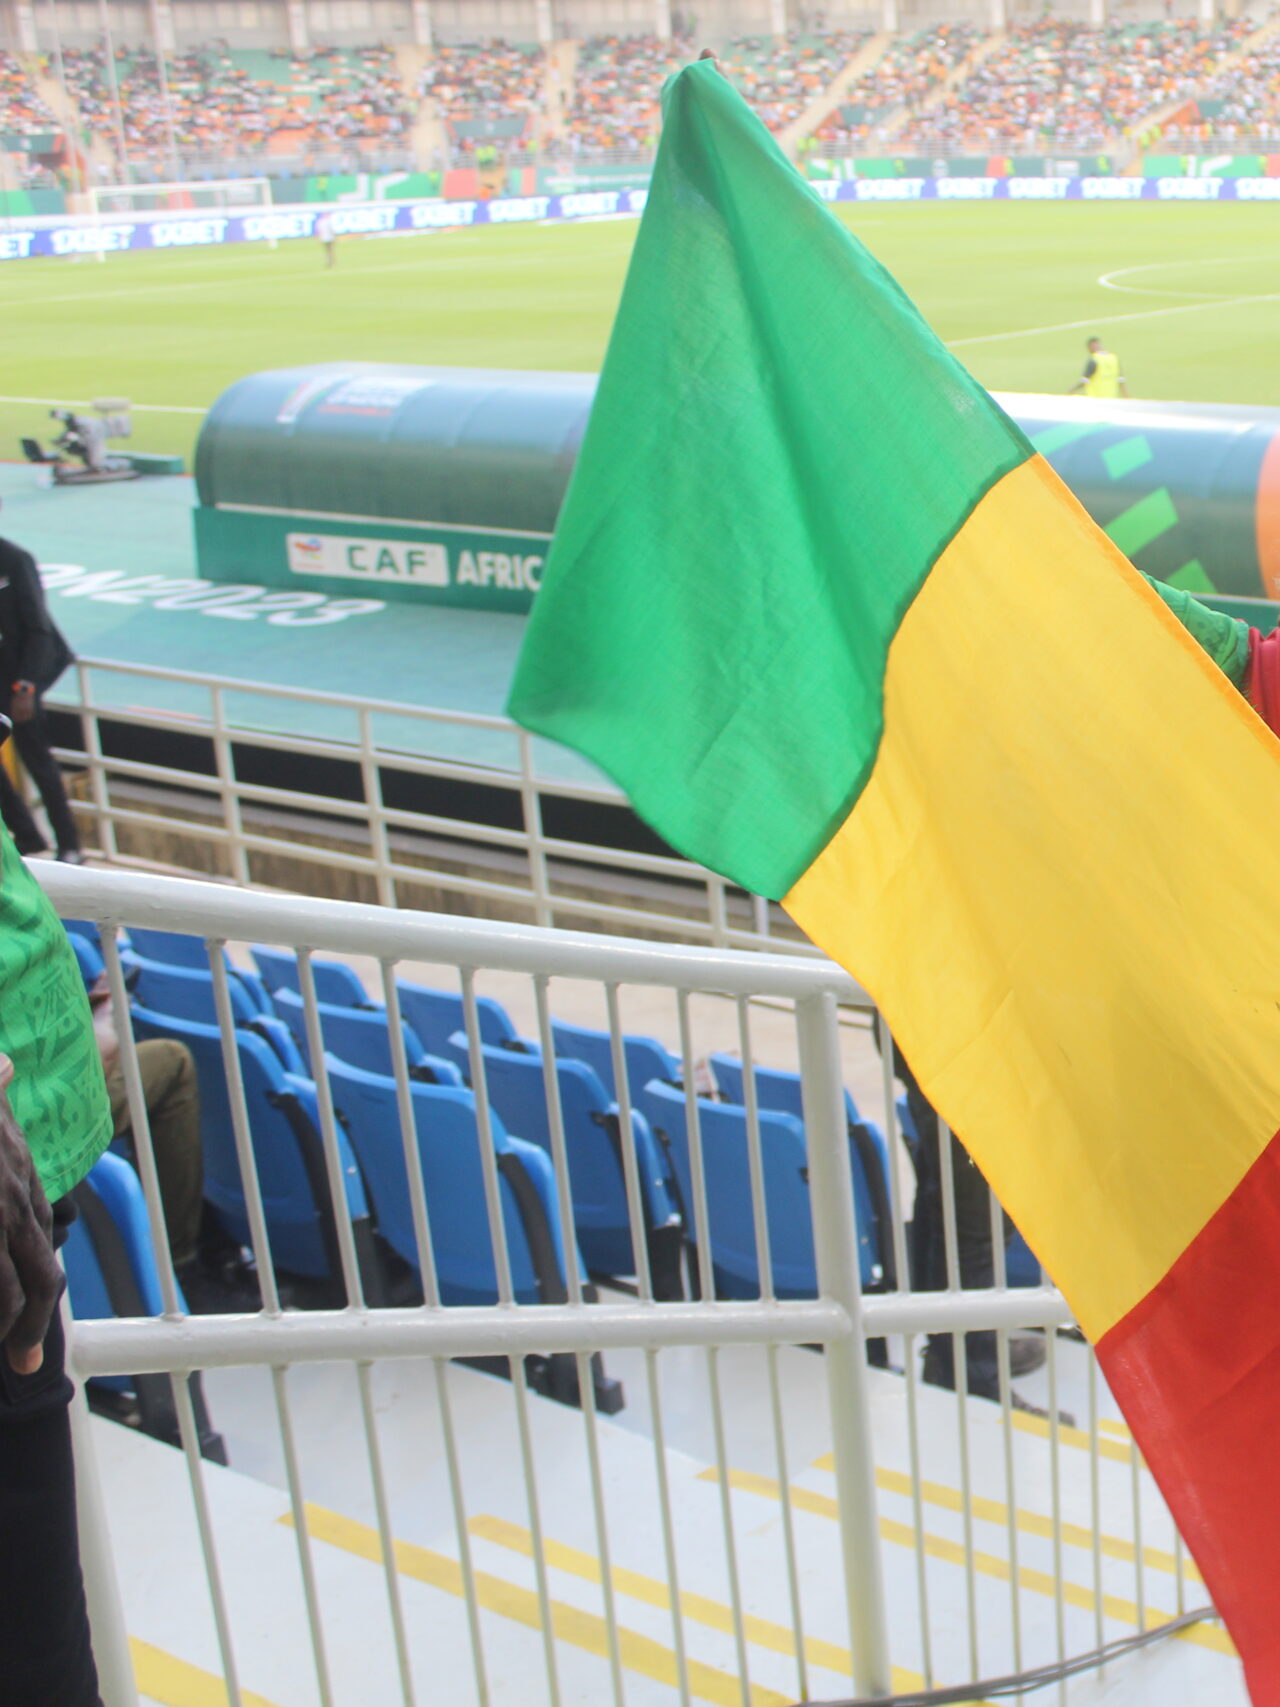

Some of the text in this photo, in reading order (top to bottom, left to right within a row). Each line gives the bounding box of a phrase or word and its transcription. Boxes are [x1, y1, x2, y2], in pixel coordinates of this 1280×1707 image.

[346, 544, 428, 576] CAF
[456, 549, 543, 592] AFRIC
[37, 562, 387, 626] N2023
